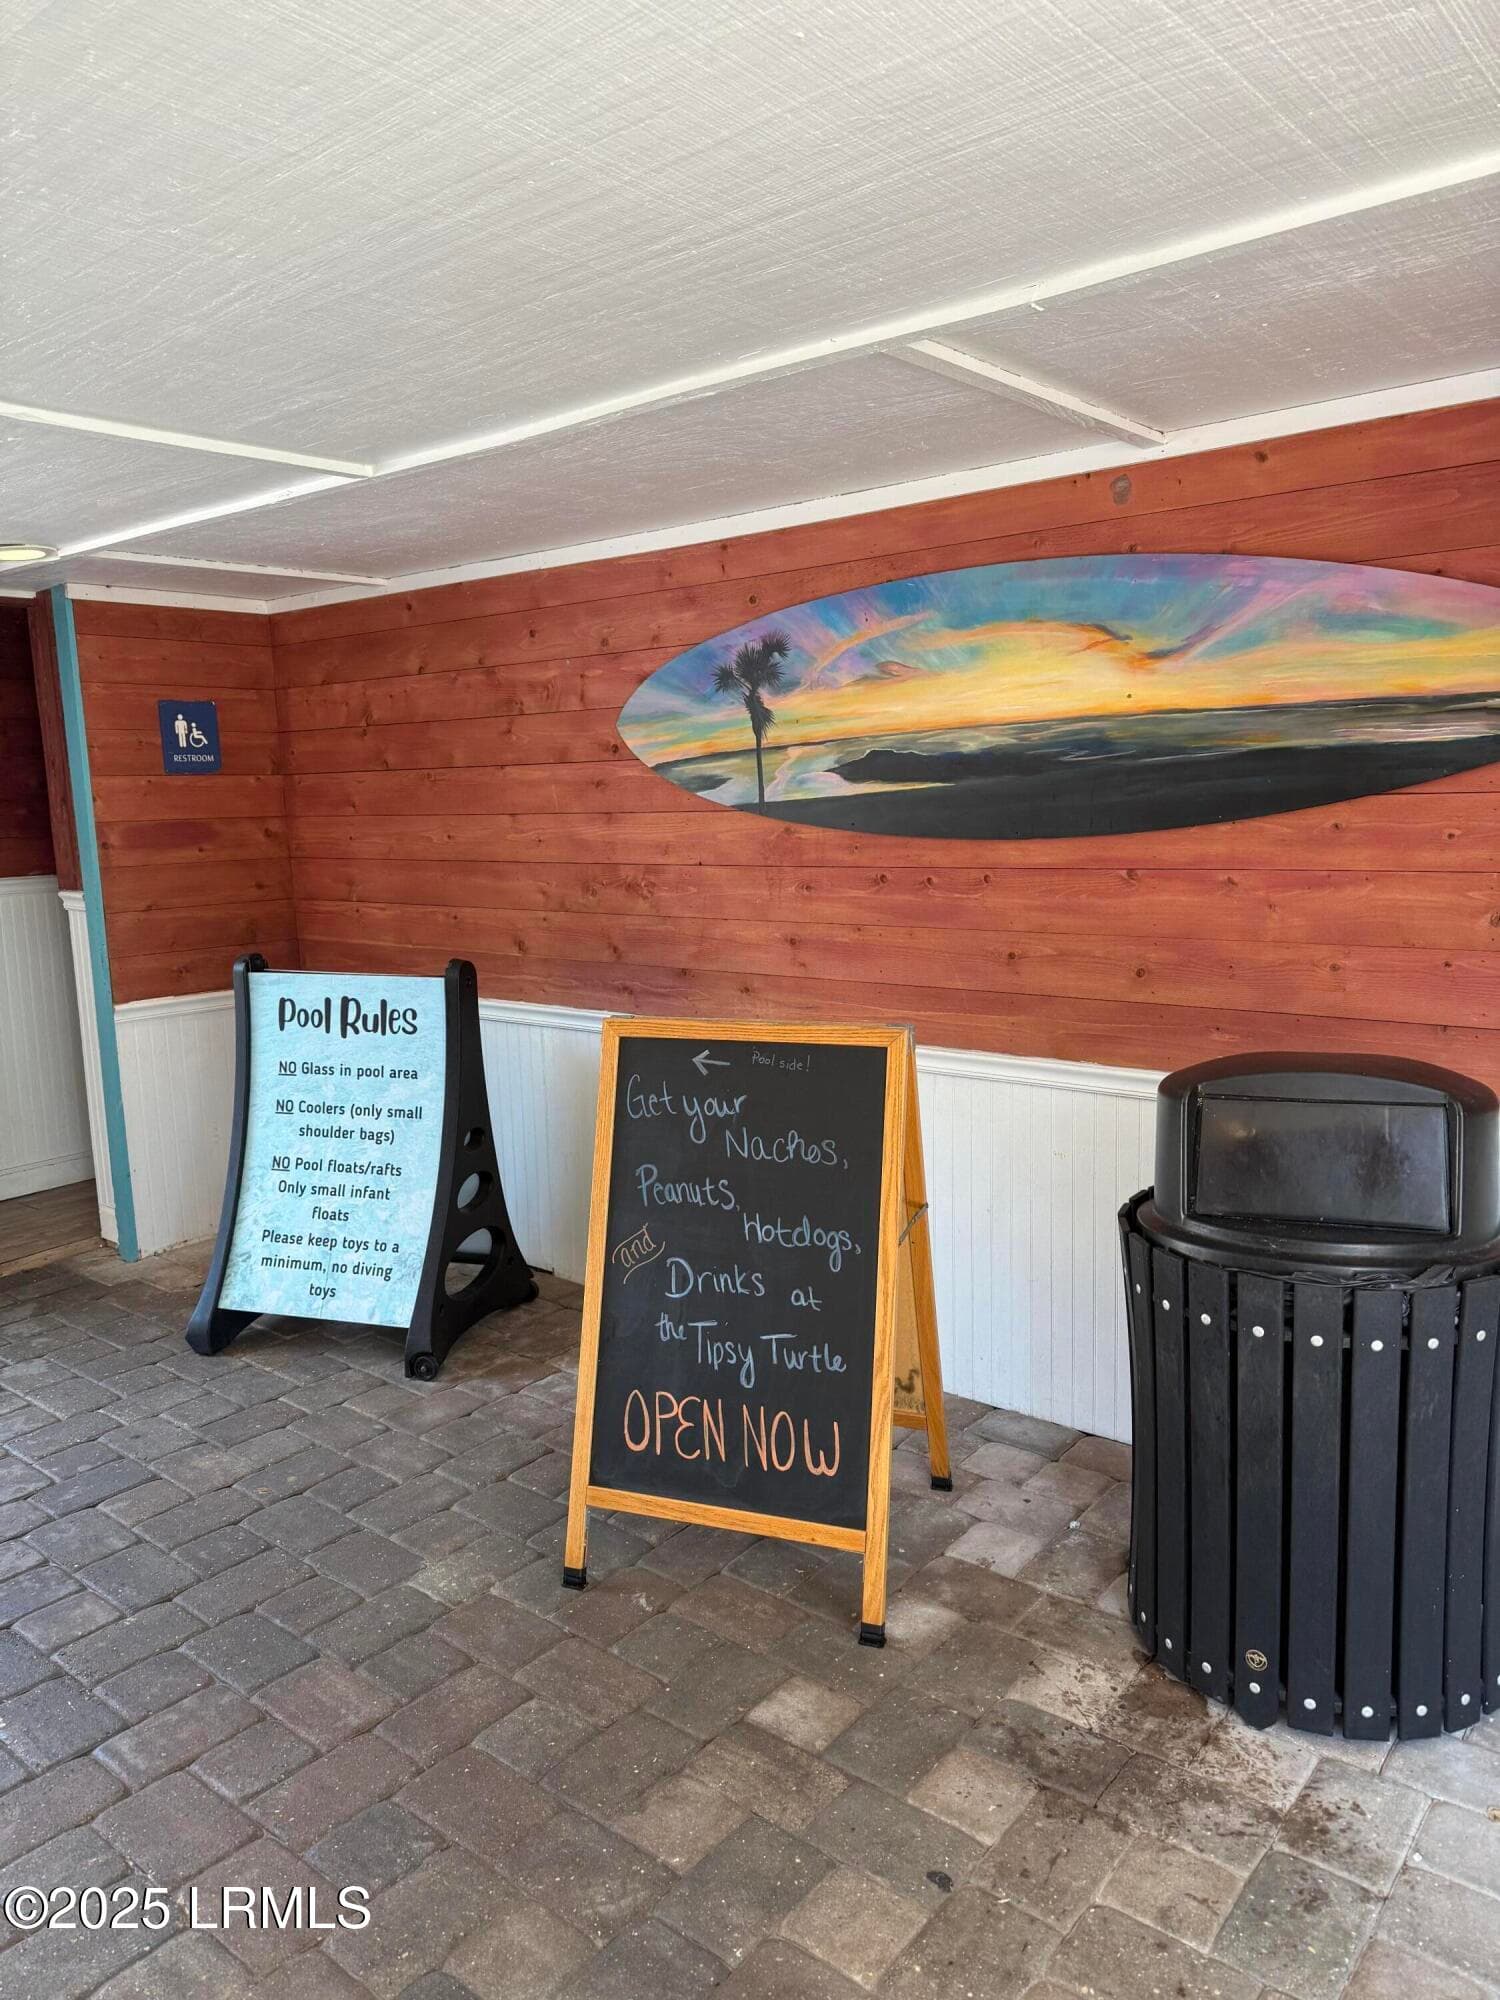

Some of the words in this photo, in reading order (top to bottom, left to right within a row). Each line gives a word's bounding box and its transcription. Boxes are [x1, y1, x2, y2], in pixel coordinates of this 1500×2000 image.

[173, 754, 215, 762] RESTROOM
[278, 997, 331, 1034] Pool
[340, 996, 418, 1039] Rules
[278, 1061, 297, 1076] NO
[301, 1062, 335, 1076] Glass
[339, 1063, 352, 1077] in
[356, 1065, 385, 1079] pool
[389, 1067, 418, 1080] area
[276, 1099, 294, 1114] NO
[298, 1100, 345, 1116] Coolers
[350, 1102, 382, 1121] (only
[387, 1106, 423, 1120] small
[626, 1074, 677, 1119] Get
[682, 1093, 747, 1144] your
[299, 1125, 355, 1140] shoulder
[359, 1128, 395, 1145] bags)
[725, 1126, 848, 1169] Nachos,
[272, 1155, 290, 1171] NO
[295, 1157, 323, 1172] Pool
[327, 1159, 402, 1177] floats/rafts
[278, 1180, 306, 1198] Only
[311, 1183, 346, 1198] small
[350, 1185, 391, 1200] infant
[635, 1164, 740, 1212] Peanuts,
[312, 1206, 350, 1222] floats
[261, 1229, 303, 1246] Please
[307, 1233, 338, 1250] keep
[342, 1237, 370, 1254] toys
[374, 1239, 387, 1252] to
[391, 1243, 399, 1253] a
[620, 1224, 657, 1268] and
[743, 1212, 862, 1272] Hotdogs,
[261, 1255, 327, 1274] minimum,
[332, 1262, 347, 1274] no
[352, 1261, 393, 1281] diving
[309, 1282, 337, 1298] toys
[665, 1257, 766, 1298] Drinks
[790, 1286, 822, 1311] at
[654, 1312, 687, 1341] the
[688, 1320, 755, 1389] Tipsy
[760, 1333, 847, 1373] Turtle
[623, 1389, 726, 1463] OPEN
[743, 1404, 840, 1477] NOW
